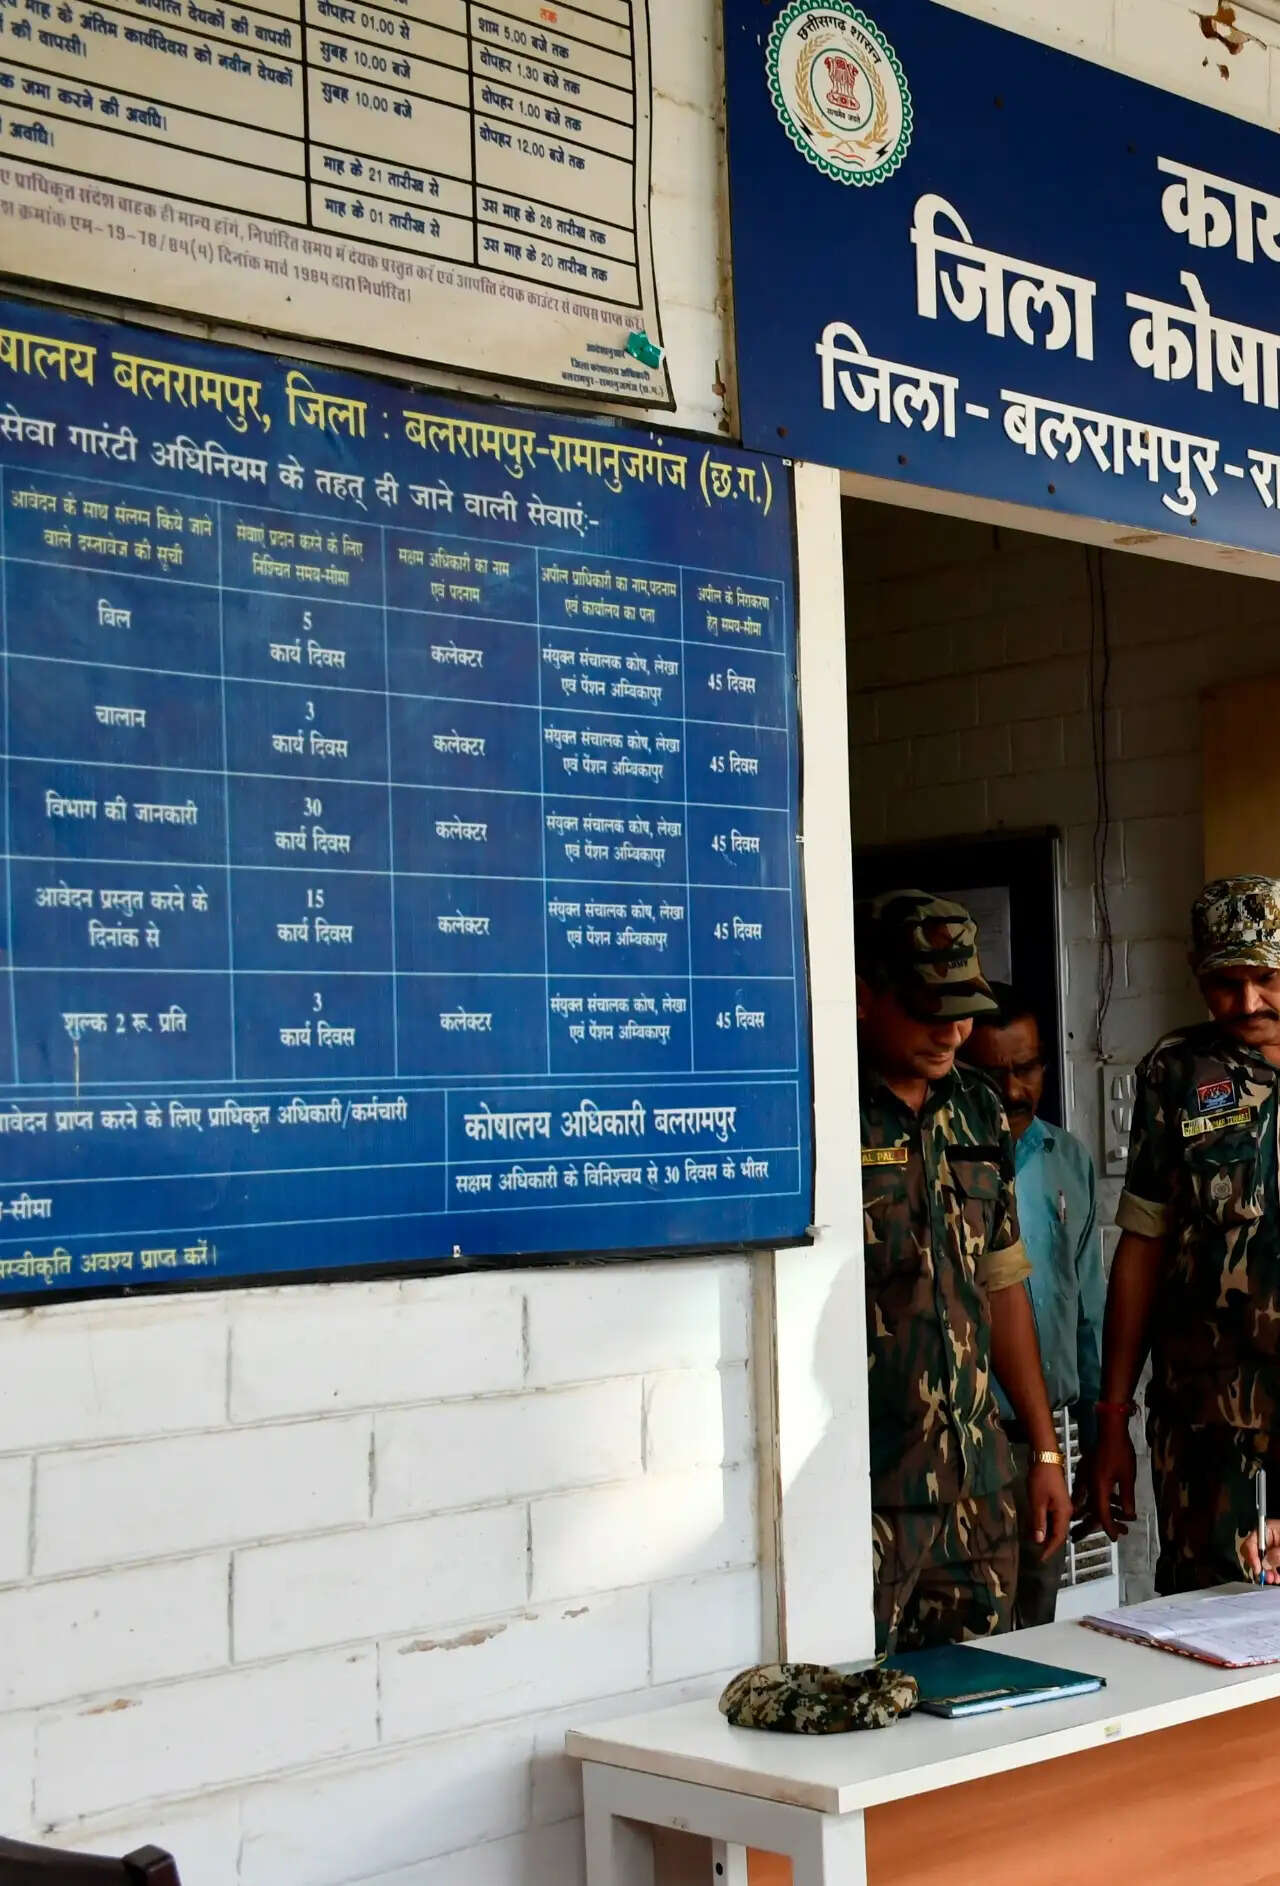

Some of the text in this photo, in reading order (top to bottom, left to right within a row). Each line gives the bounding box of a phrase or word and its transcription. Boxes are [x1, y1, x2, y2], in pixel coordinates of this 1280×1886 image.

[231, 17, 249, 36] की
[254, 24, 292, 49] वापसी
[478, 17, 499, 35] शाम
[531, 34, 548, 54] बजे
[551, 43, 570, 60] तक
[850, 25, 883, 64] शासन
[320, 40, 347, 63] सुबह
[392, 59, 411, 80] बजे
[480, 48, 512, 74] दोपहर
[543, 69, 559, 89] बजे
[563, 79, 581, 96] तक
[21, 78, 51, 100] जमा
[57, 88, 93, 112] करने
[100, 96, 120, 118] की
[321, 81, 349, 104] सुबह
[393, 100, 413, 120] बजे
[481, 87, 514, 111] दोपहर
[544, 107, 561, 127] बजे
[565, 116, 582, 132] तक
[479, 124, 512, 149] दोपहर
[549, 145, 565, 165] बजे
[569, 155, 586, 171] तक
[323, 155, 345, 175] माह
[350, 159, 364, 178] के
[368, 166, 382, 183] 21
[428, 178, 440, 198] से
[324, 197, 346, 218] माह
[352, 200, 365, 220] के
[370, 208, 383, 225] 01
[430, 218, 440, 239] से
[502, 203, 521, 222] माह
[524, 206, 536, 225] के
[589, 228, 607, 246] तक
[504, 241, 522, 260] माह
[526, 244, 537, 263] के
[541, 252, 554, 268] 20
[591, 265, 608, 283] तक
[909, 193, 1096, 361] जिला
[111, 351, 271, 434] बलरामपुर,
[285, 370, 367, 438] जिला
[699, 450, 773, 518] (छ.ग.)
[0, 404, 57, 448] सेवा
[69, 422, 138, 463] गारंटी
[151, 435, 268, 485] अधिनियम
[278, 454, 304, 490] के
[375, 471, 399, 507] दी
[408, 479, 453, 513] जाने
[463, 490, 517, 523] वाली
[98, 598, 132, 629] बिल
[304, 610, 313, 631] 5
[269, 638, 346, 669] कार्य दिवस
[708, 668, 755, 694] 45 दिवस
[94, 704, 146, 729] चालान
[305, 702, 315, 721] 3
[272, 729, 348, 758] कार्य दिवस
[709, 750, 758, 777] 45 दिवस
[46, 790, 198, 825] विभाग की जानकारी
[304, 797, 322, 818] 30
[275, 825, 350, 854] कार्य दिवस
[711, 829, 760, 854] 45 दिवस
[36, 880, 93, 910] आवेदन
[151, 884, 185, 911] करने
[191, 885, 209, 912] के
[306, 889, 324, 909] 15
[88, 919, 160, 948] दिनांक से
[277, 917, 353, 945] कार्य दिवस
[713, 917, 762, 940] 45 दिवस
[312, 992, 322, 1012] 3
[716, 1004, 765, 1029] 45 दिवस
[280, 1021, 355, 1047] कार्य दिवस
[55, 1110, 93, 1132] प्राप्त
[101, 1102, 138, 1131] करने
[145, 1102, 163, 1129] के
[170, 1100, 203, 1133] लिए
[208, 1099, 270, 1133] प्राधिकृत
[464, 1099, 737, 1143] कोषालय अधिकारी बलरामपुर
[455, 1174, 492, 1194] सक्षम
[498, 1165, 558, 1192] अधिकारी
[564, 1164, 578, 1188] के
[646, 1161, 658, 1185] से
[664, 1165, 680, 1185] 30
[684, 1160, 717, 1183] दिवस
[722, 1156, 735, 1179] के
[740, 1156, 769, 1179] भीतर
[140, 1247, 177, 1270] प्राप्त
